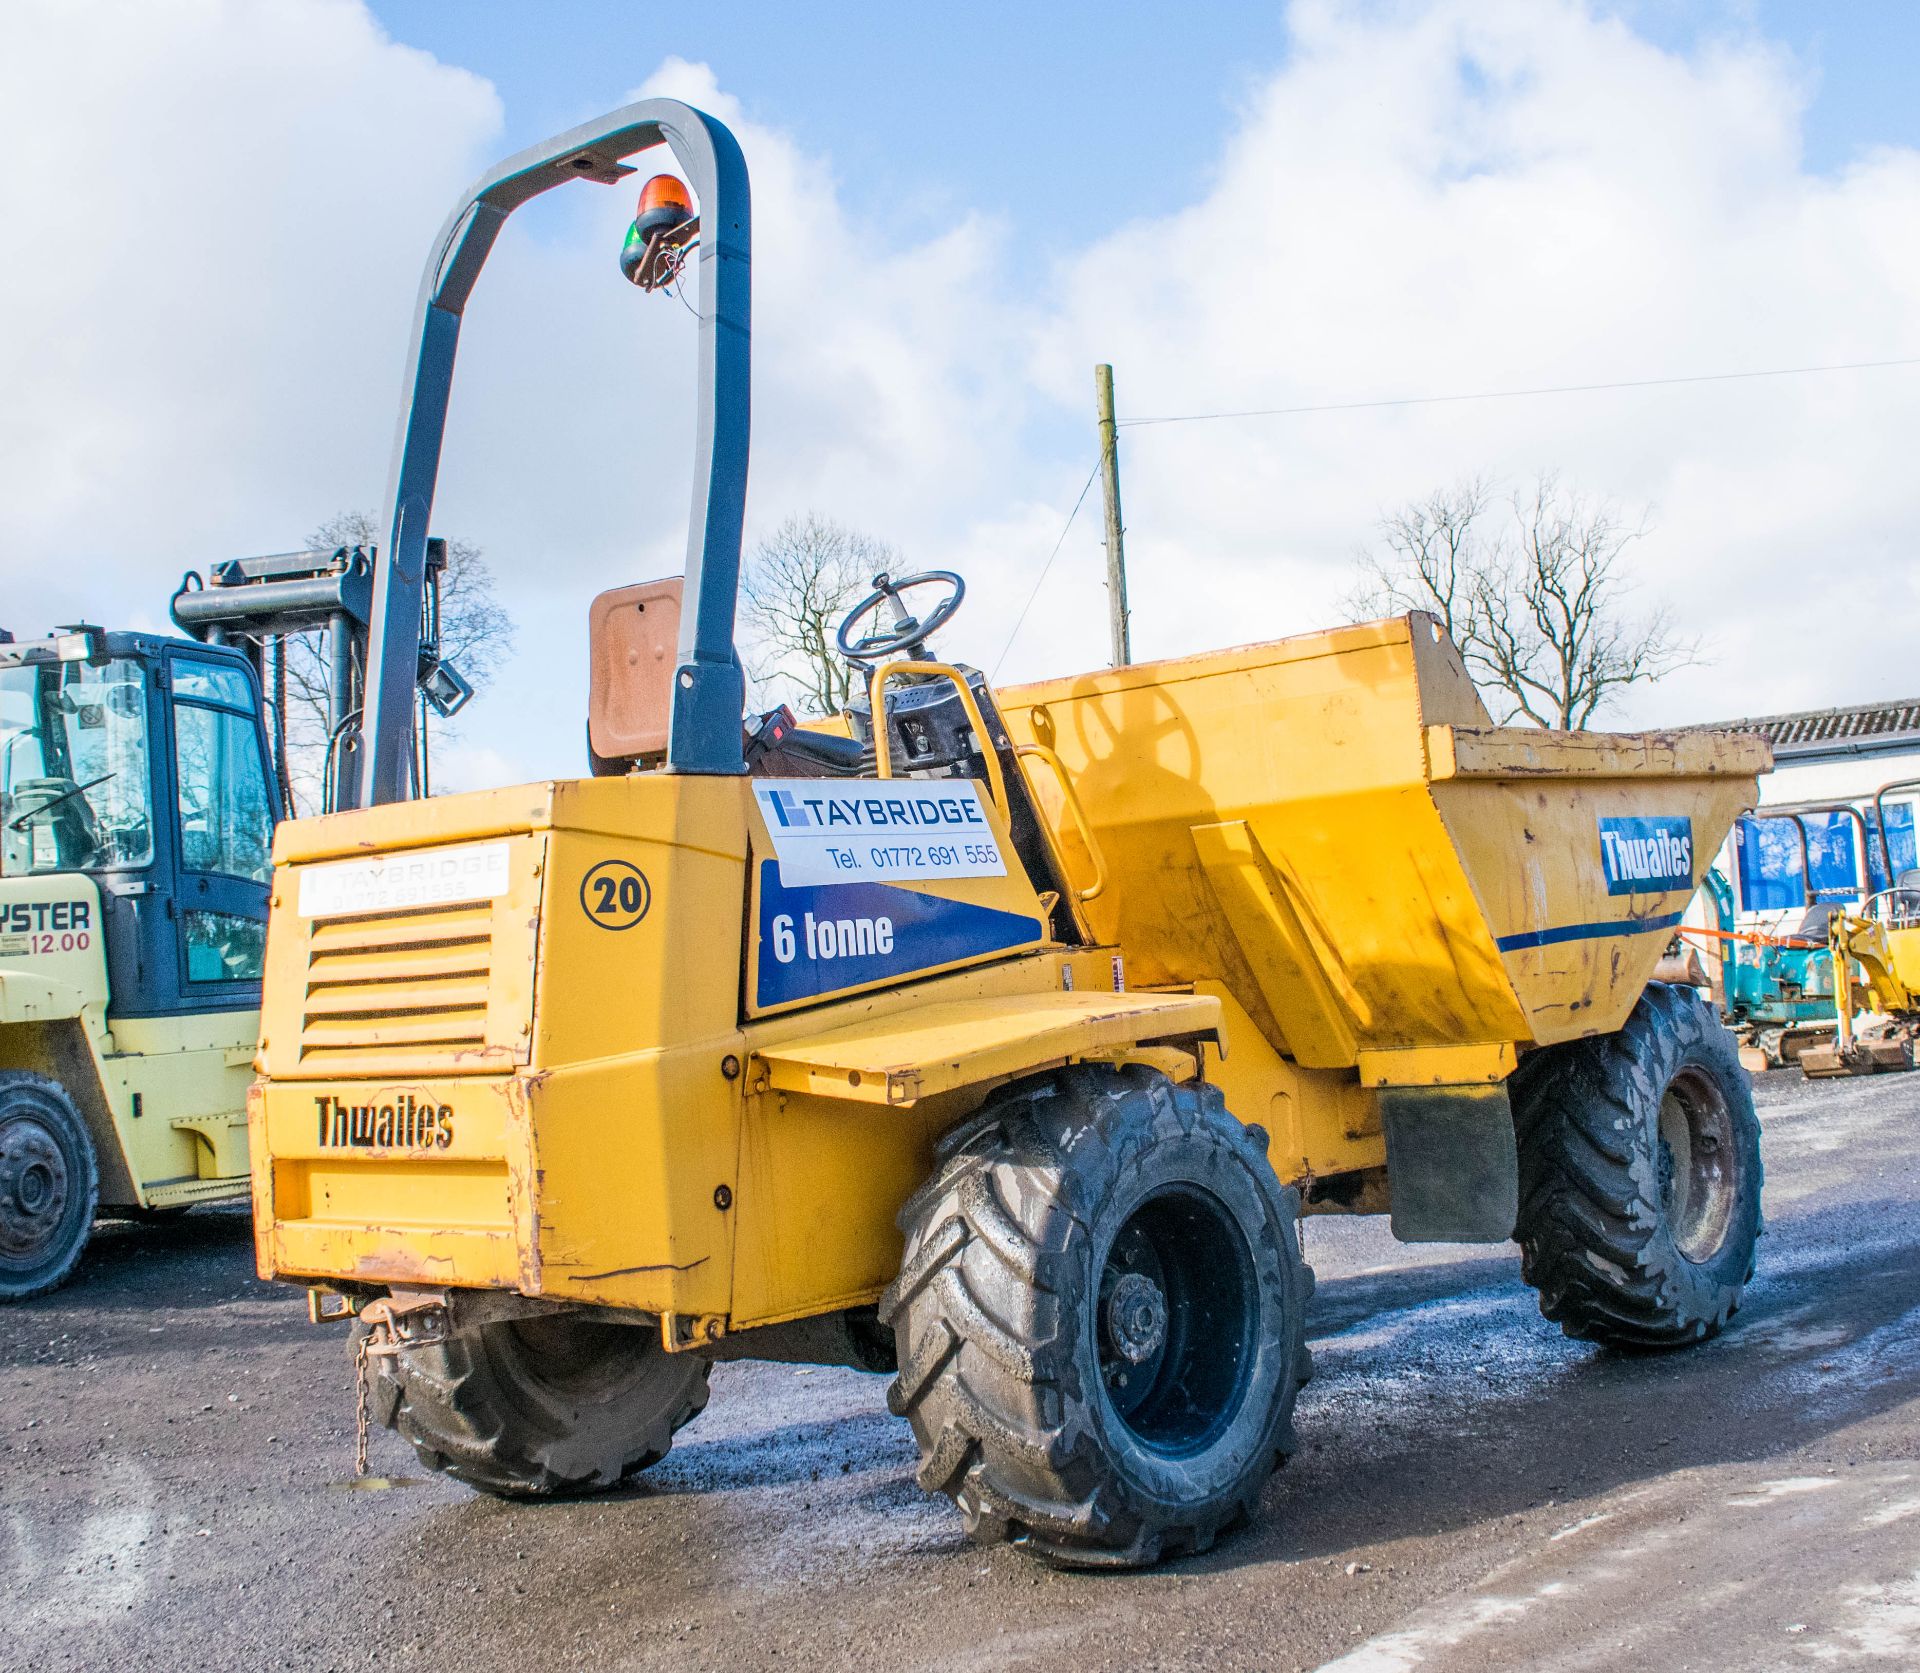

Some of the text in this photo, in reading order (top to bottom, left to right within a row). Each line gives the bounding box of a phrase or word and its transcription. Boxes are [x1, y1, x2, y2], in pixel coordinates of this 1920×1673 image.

[803, 799, 983, 826] TAYBRIDGE
[337, 853, 502, 890] TAYBRIDGE
[826, 844, 998, 869] Tel. 01772 691 555
[1600, 828, 1690, 881] Thwaites
[593, 877, 642, 913] 20
[31, 932, 90, 954] 12.00
[772, 912, 894, 963] 6 tonne
[315, 1095, 454, 1149] Thwaites
